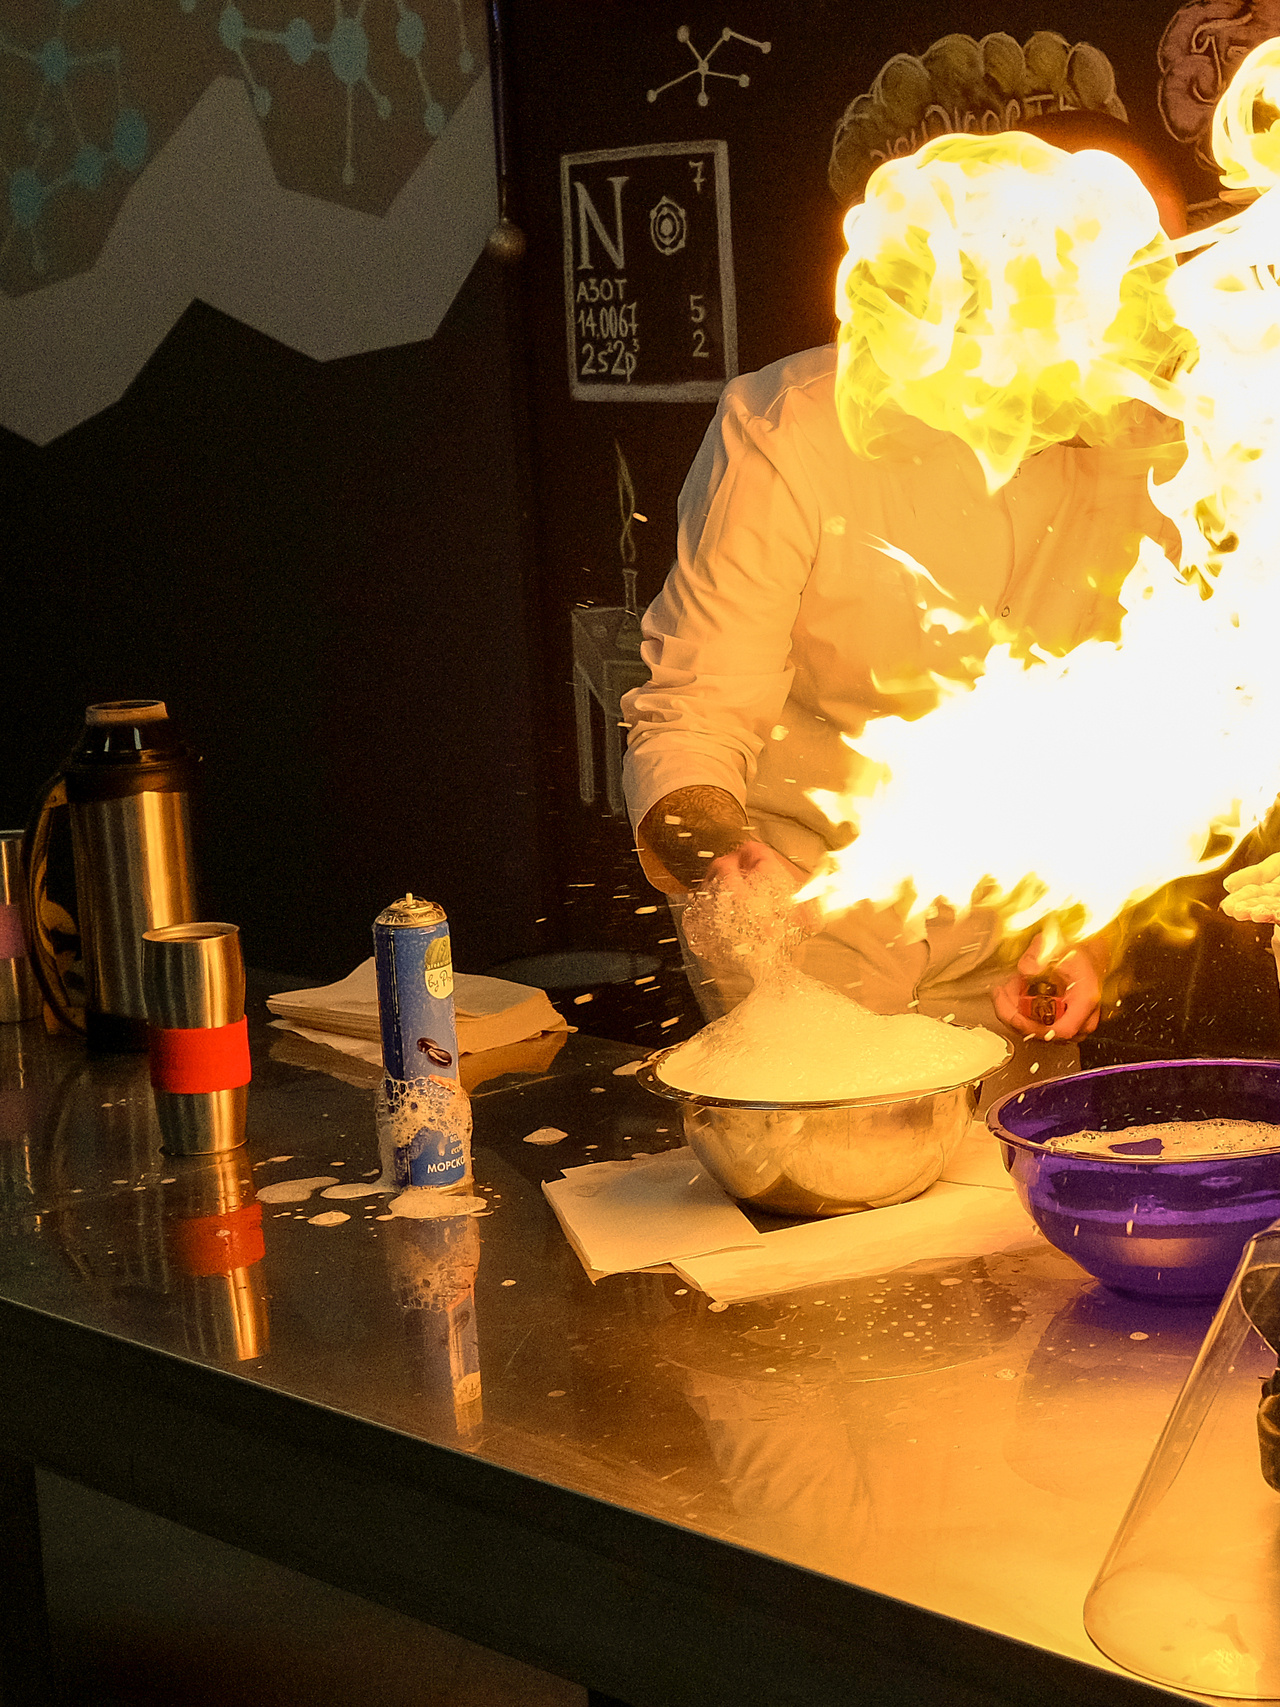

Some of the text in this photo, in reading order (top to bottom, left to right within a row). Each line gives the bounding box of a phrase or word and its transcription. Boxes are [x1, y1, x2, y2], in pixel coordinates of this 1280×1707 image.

[689, 161, 706, 192] 7
[573, 176, 630, 269] N
[576, 278, 627, 303] АЗОТ
[689, 294, 705, 323] 5
[692, 329, 709, 358] 2
[427, 1155, 465, 1174] МОРСКО
